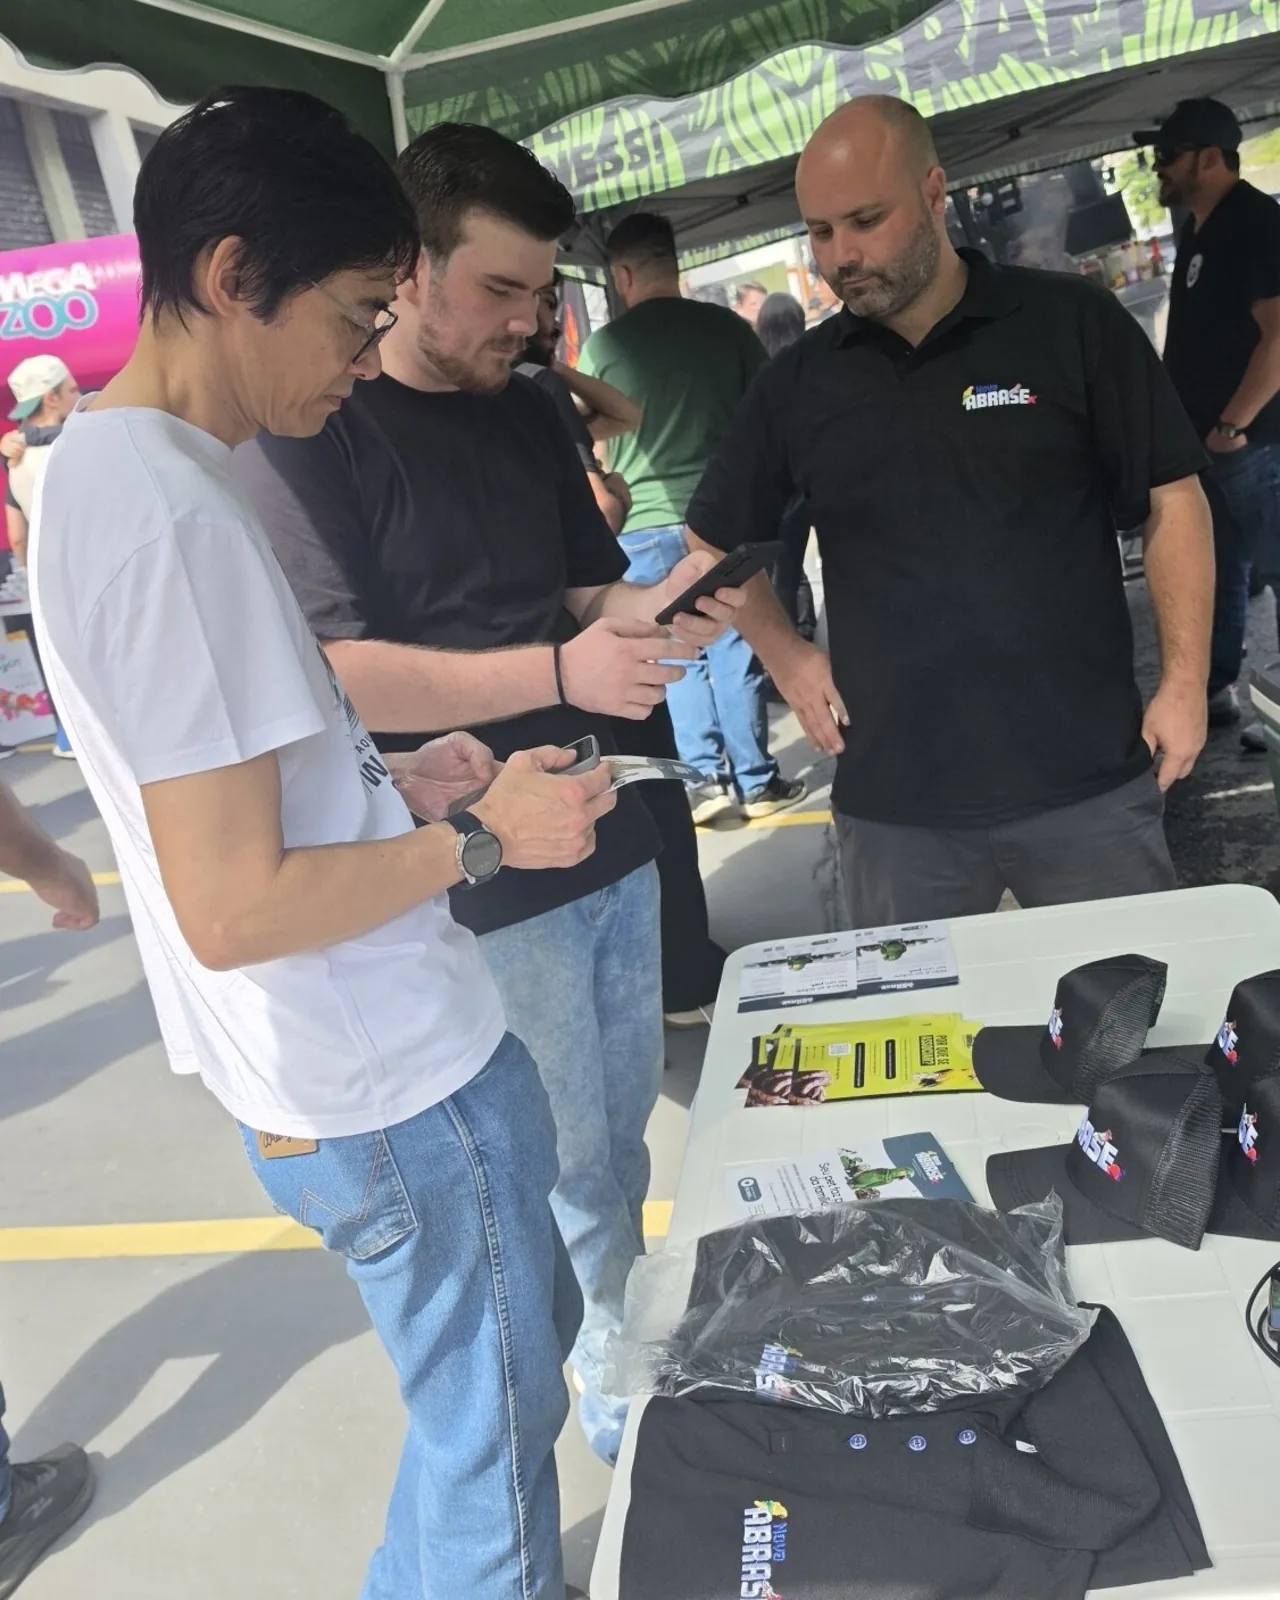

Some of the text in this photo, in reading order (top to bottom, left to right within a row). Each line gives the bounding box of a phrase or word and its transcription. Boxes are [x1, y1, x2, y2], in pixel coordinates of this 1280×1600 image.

[0, 262, 96, 301] MEGA
[0, 290, 99, 339] ZOO
[965, 388, 1030, 411] ABRASE
[819, 1162, 831, 1175] Seu
[822, 1175, 837, 1187] pet
[740, 1507, 773, 1600] ABRAS
